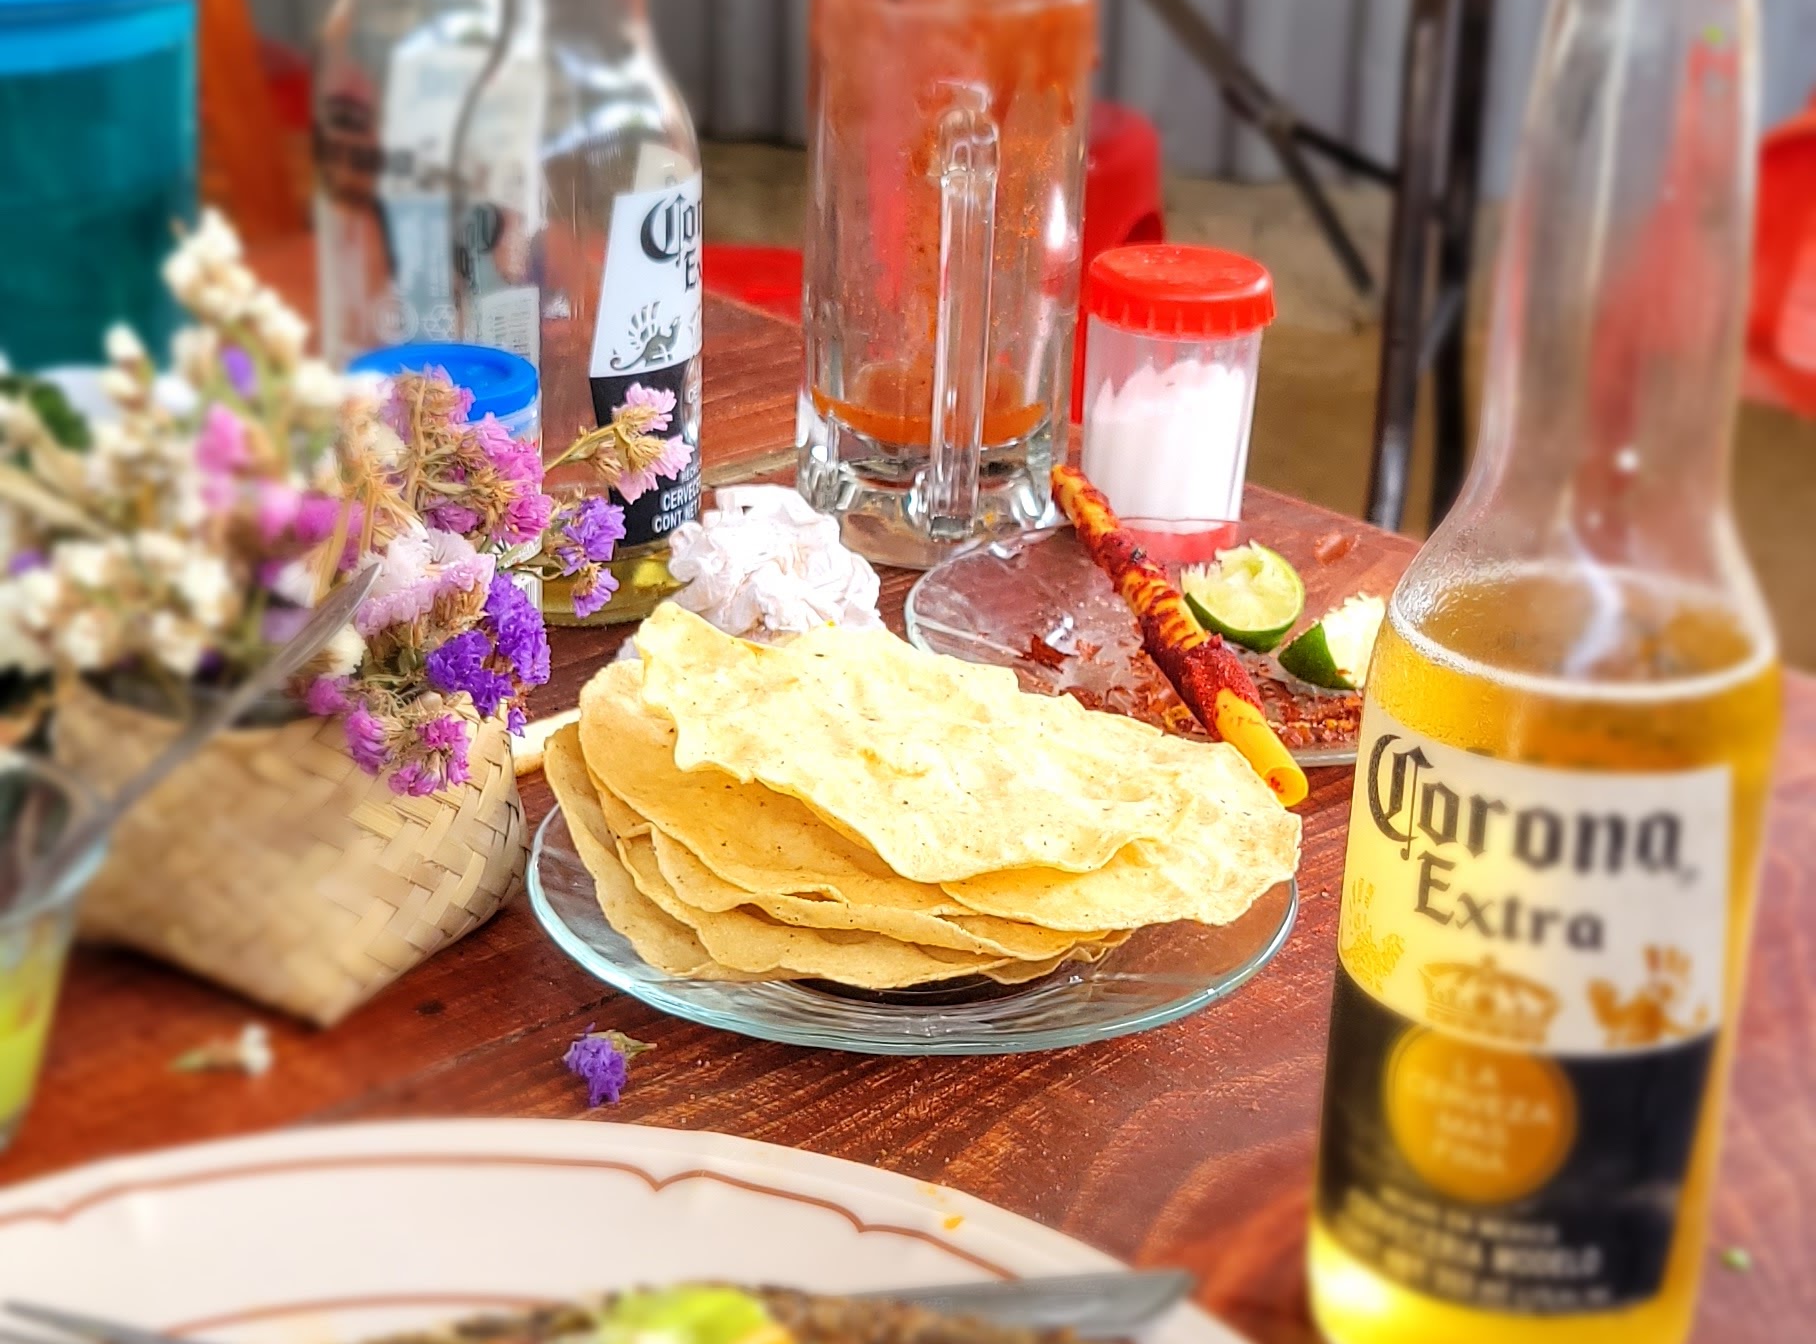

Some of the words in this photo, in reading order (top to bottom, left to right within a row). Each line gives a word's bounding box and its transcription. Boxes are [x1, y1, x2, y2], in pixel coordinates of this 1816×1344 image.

[1367, 733, 1682, 876] Corona
[1414, 850, 1606, 951] Extra
[1404, 1068, 1554, 1126] CERVEZA
[1452, 1058, 1501, 1089] LA
